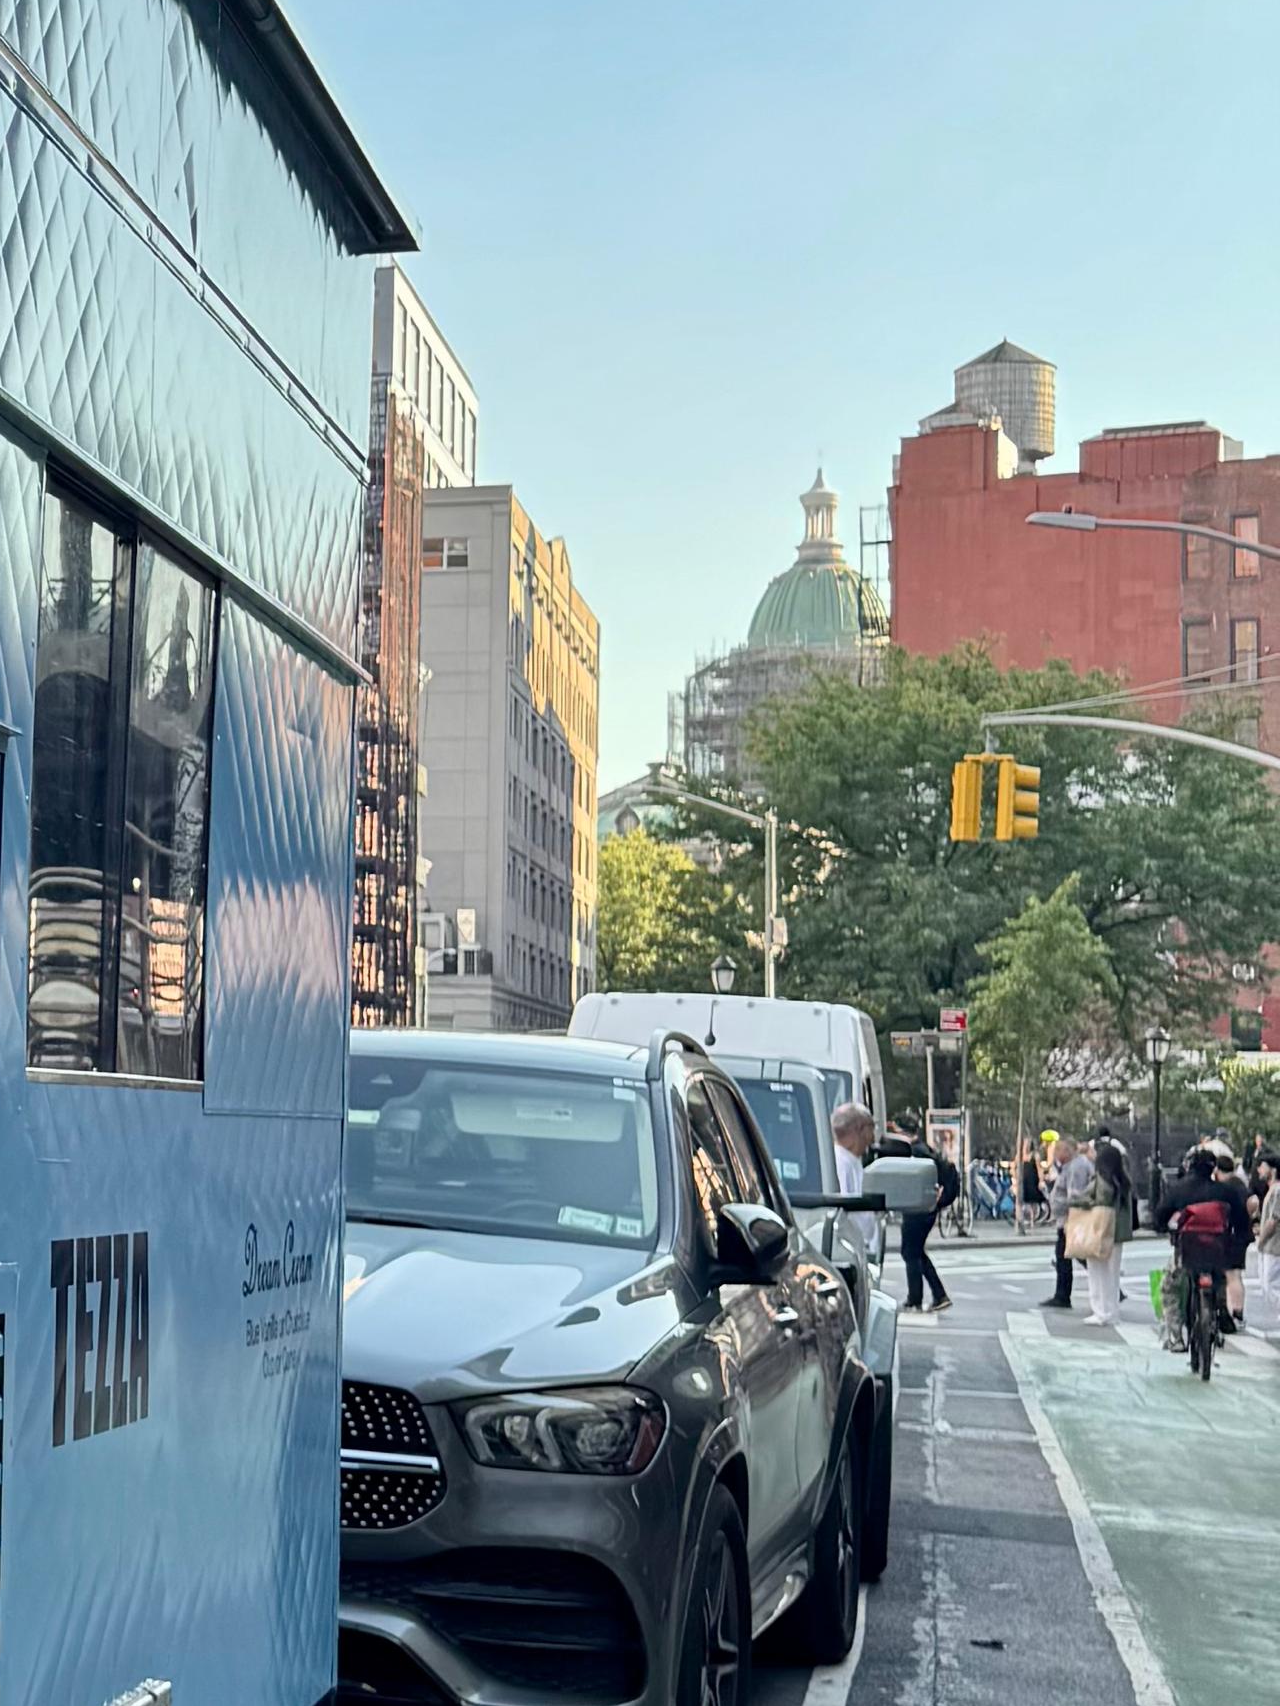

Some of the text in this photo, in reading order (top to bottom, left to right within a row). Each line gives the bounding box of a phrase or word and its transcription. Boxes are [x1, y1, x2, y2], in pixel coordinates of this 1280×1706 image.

[242, 1219, 312, 1297] Dream Cream
[50, 1231, 149, 1448] TEZZA
